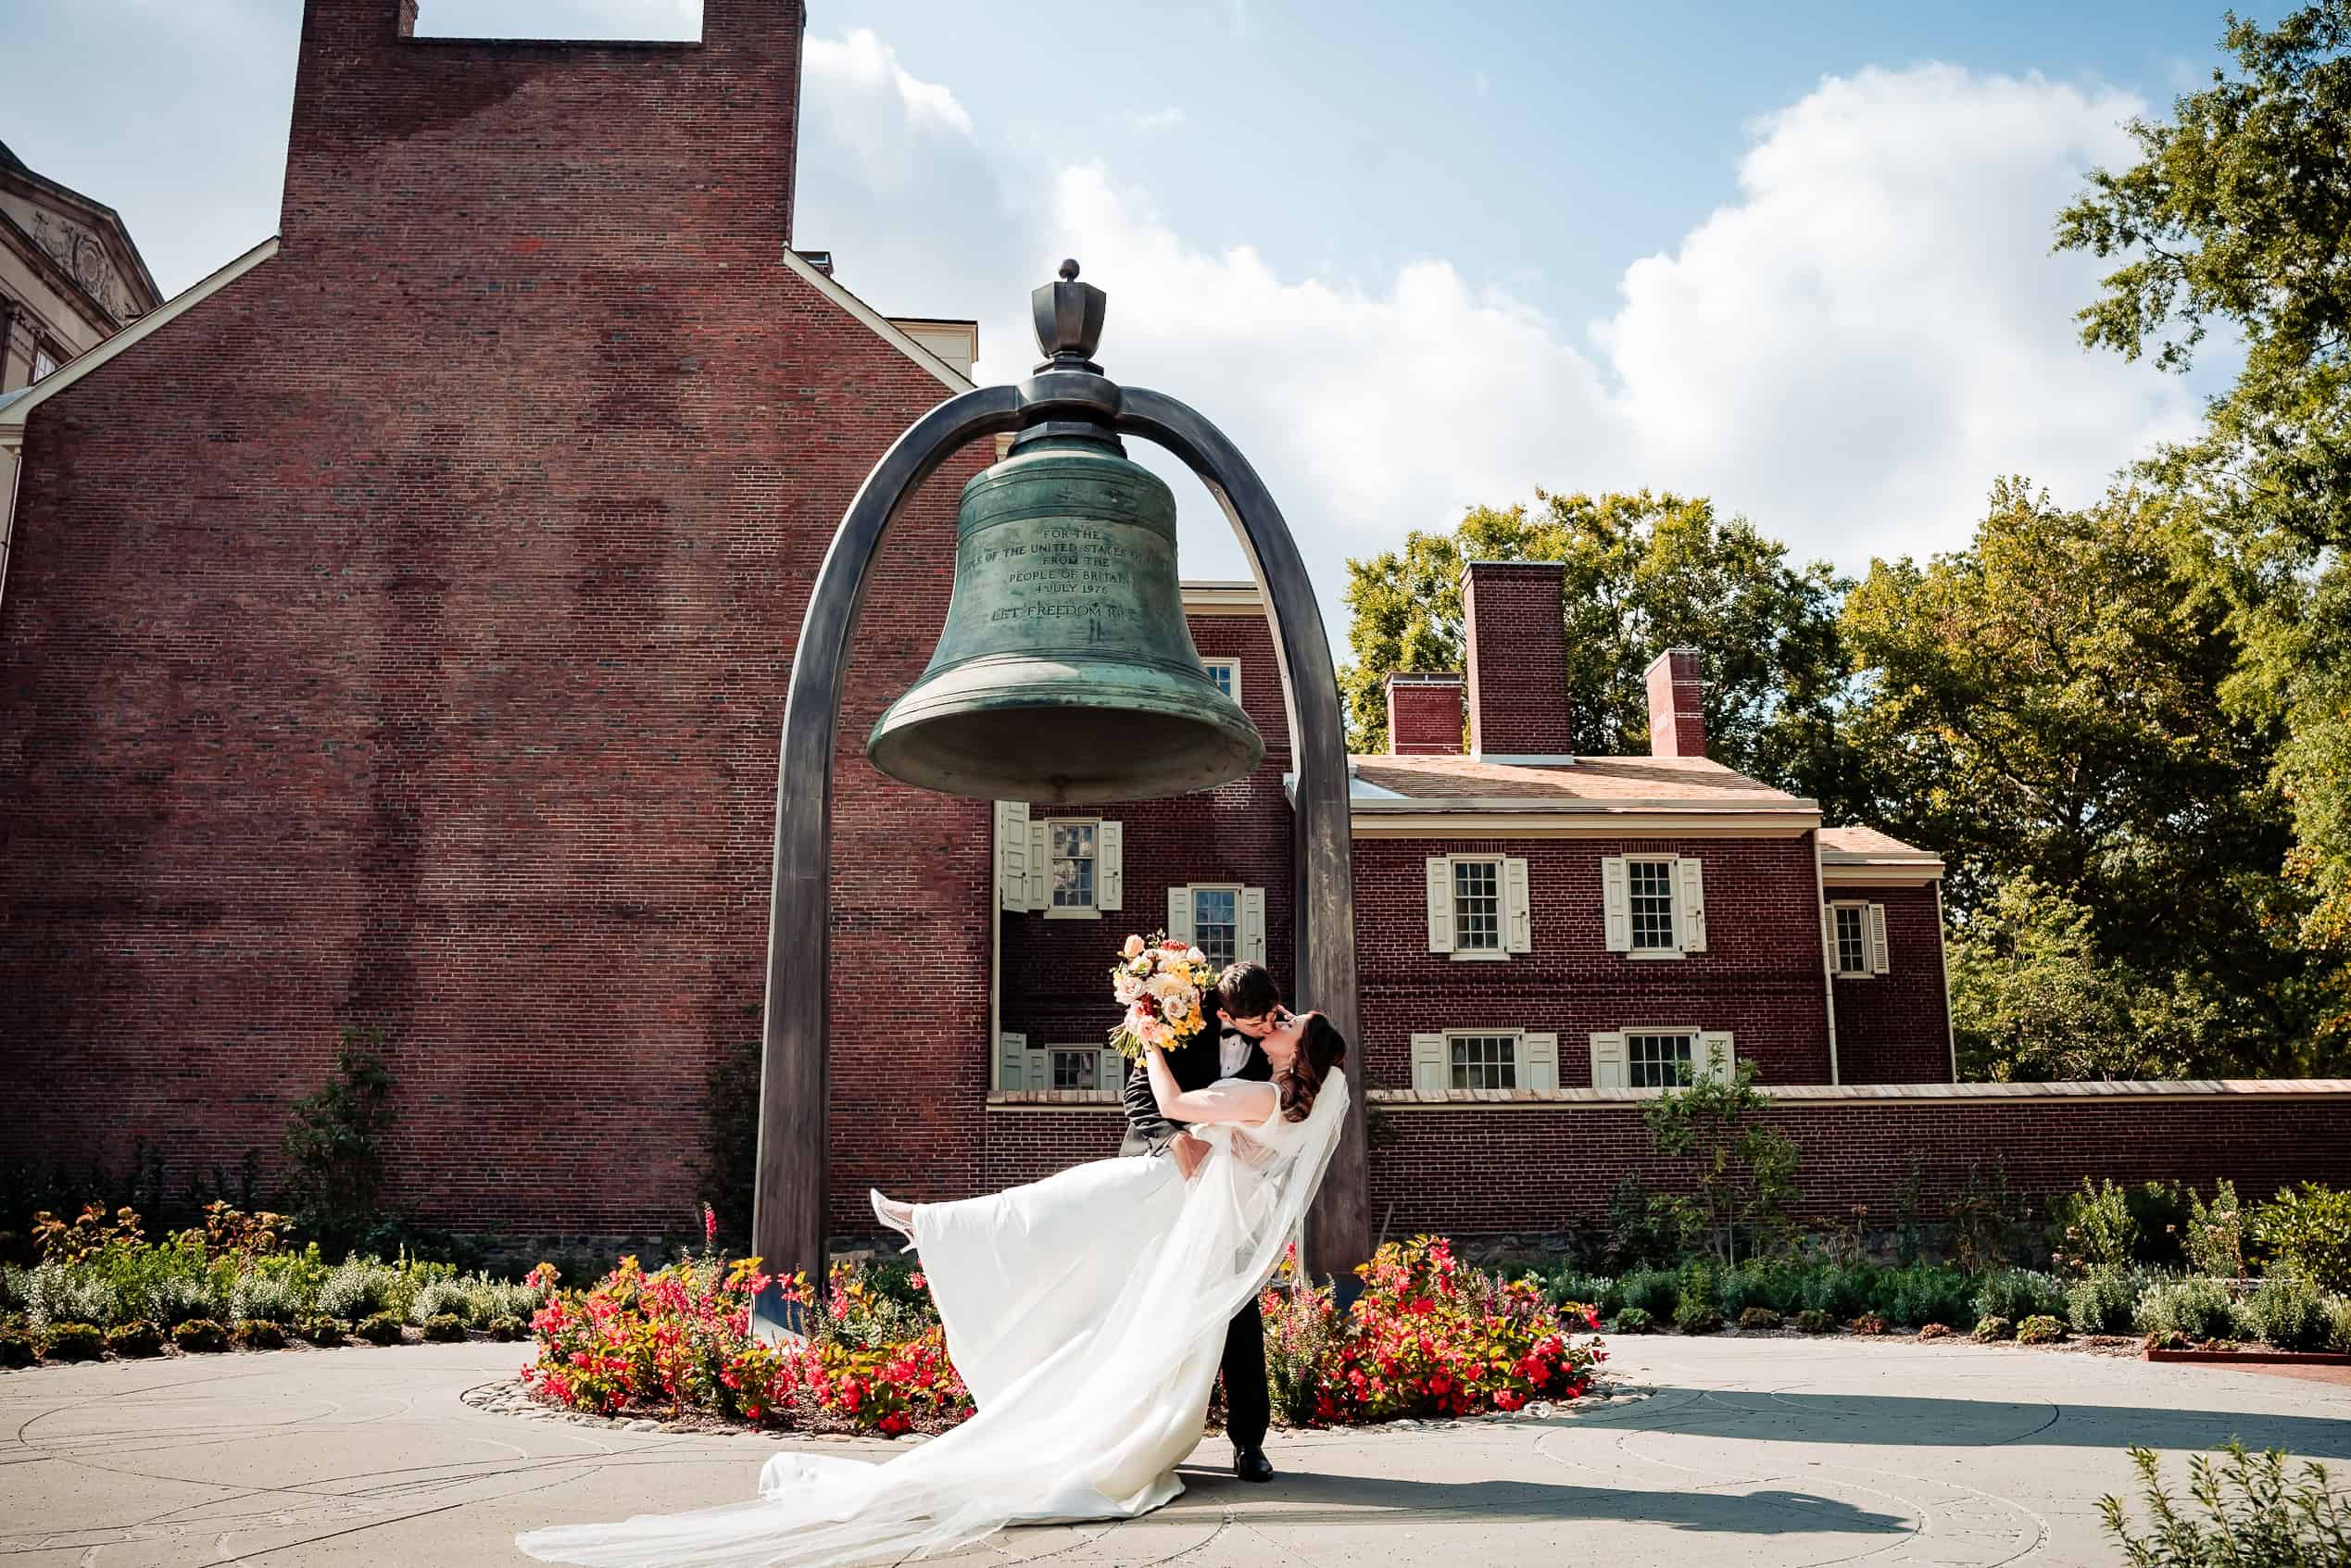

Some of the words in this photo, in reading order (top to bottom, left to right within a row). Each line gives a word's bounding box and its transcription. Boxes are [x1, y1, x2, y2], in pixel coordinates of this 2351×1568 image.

[1043, 529, 1068, 539] FOR
[1074, 530, 1100, 539] THE
[1002, 546, 1025, 558] THE
[1030, 543, 1076, 553] UNITED
[1084, 557, 1110, 567] THE
[1010, 571, 1055, 583] PEOPLE
[1062, 570, 1078, 579] OF
[1028, 605, 1100, 617] FREEDOM
